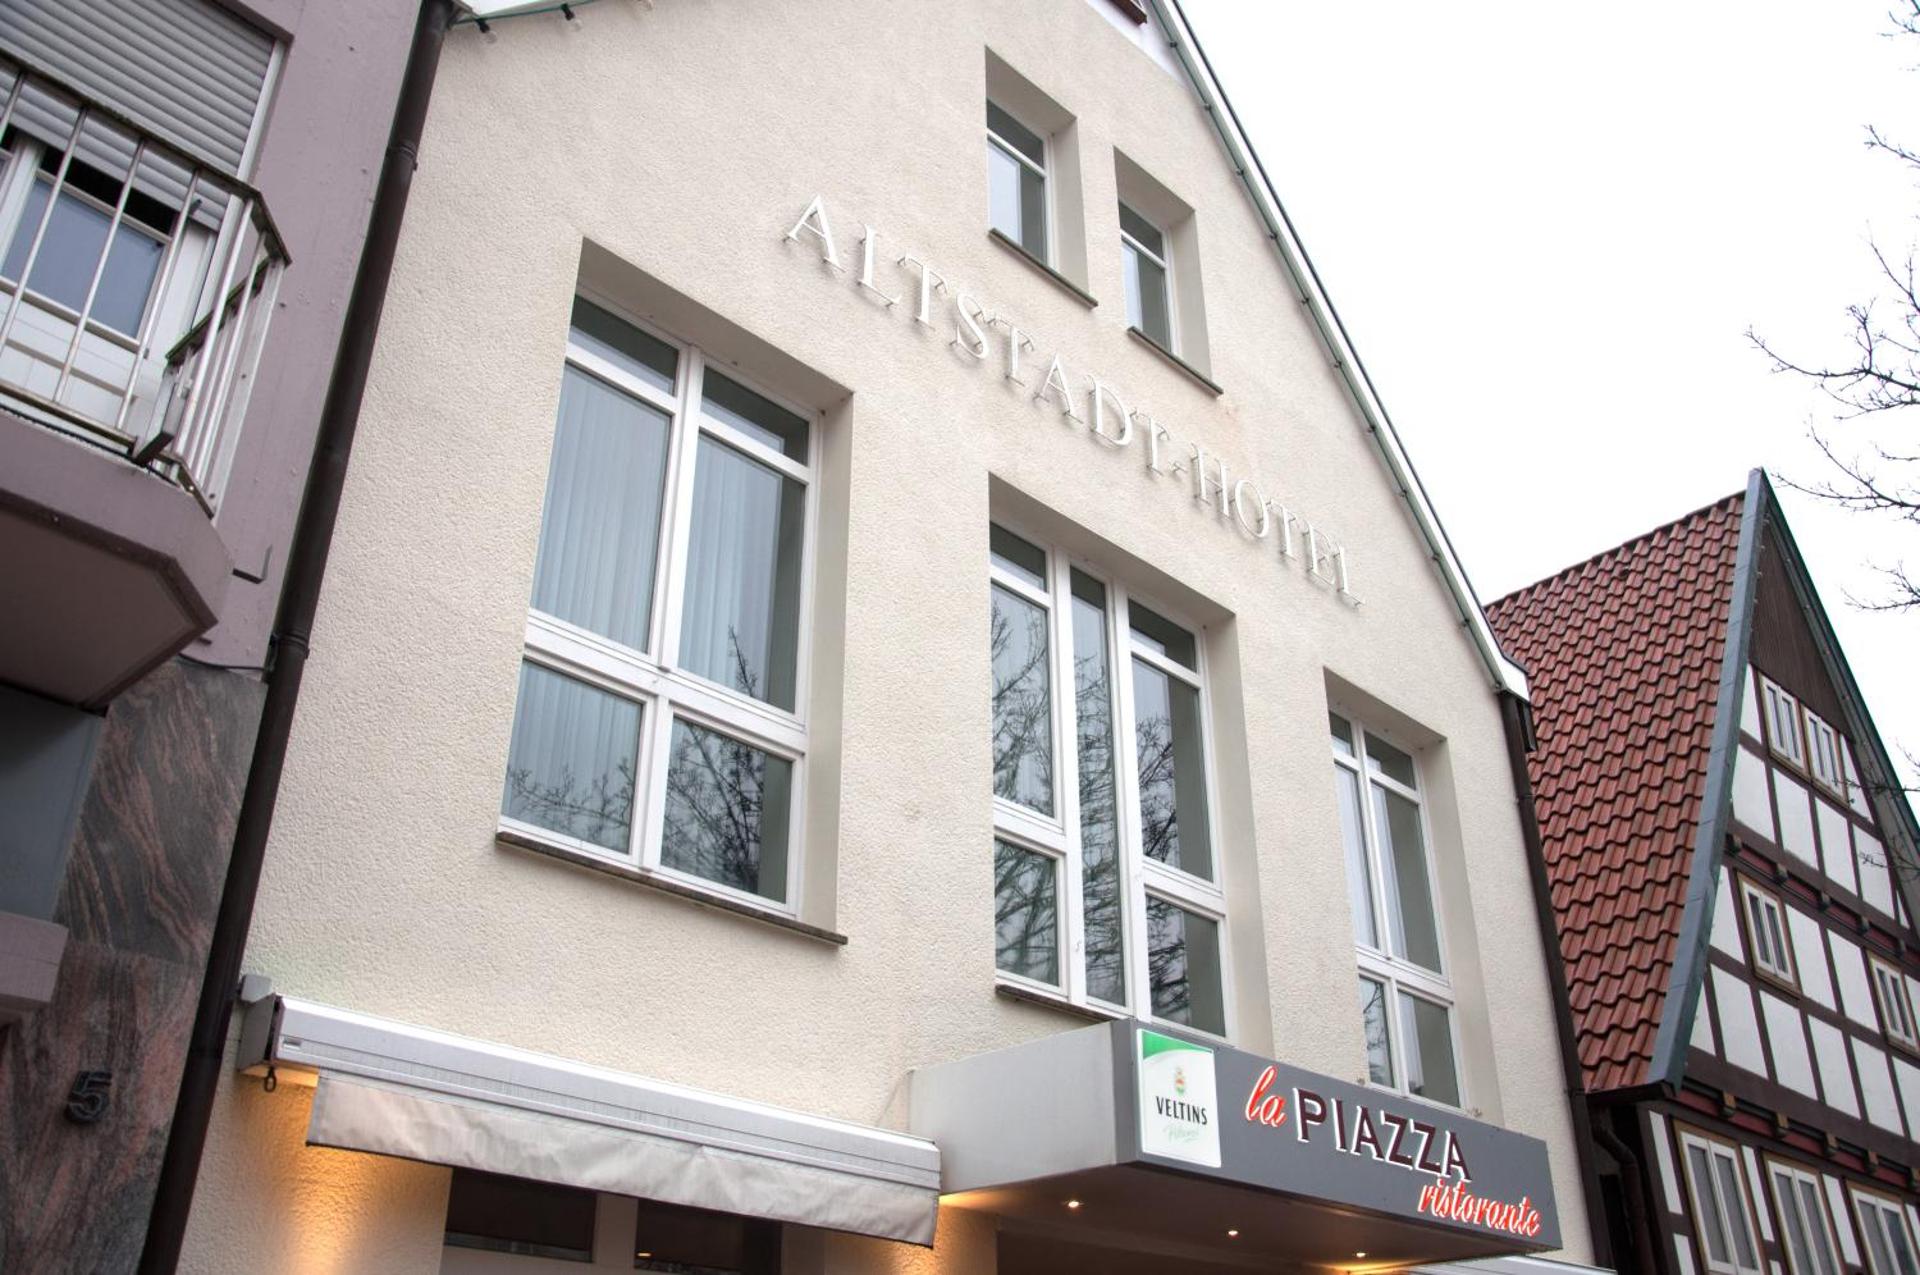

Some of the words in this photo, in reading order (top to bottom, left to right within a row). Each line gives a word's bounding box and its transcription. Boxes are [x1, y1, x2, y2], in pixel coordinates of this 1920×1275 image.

[67, 1070, 112, 1122] 5
[1155, 1095, 1208, 1125] VELTINS
[1245, 1065, 1287, 1128] la
[1293, 1087, 1472, 1182] PIAZZA
[1417, 1177, 1542, 1237] ristorante
